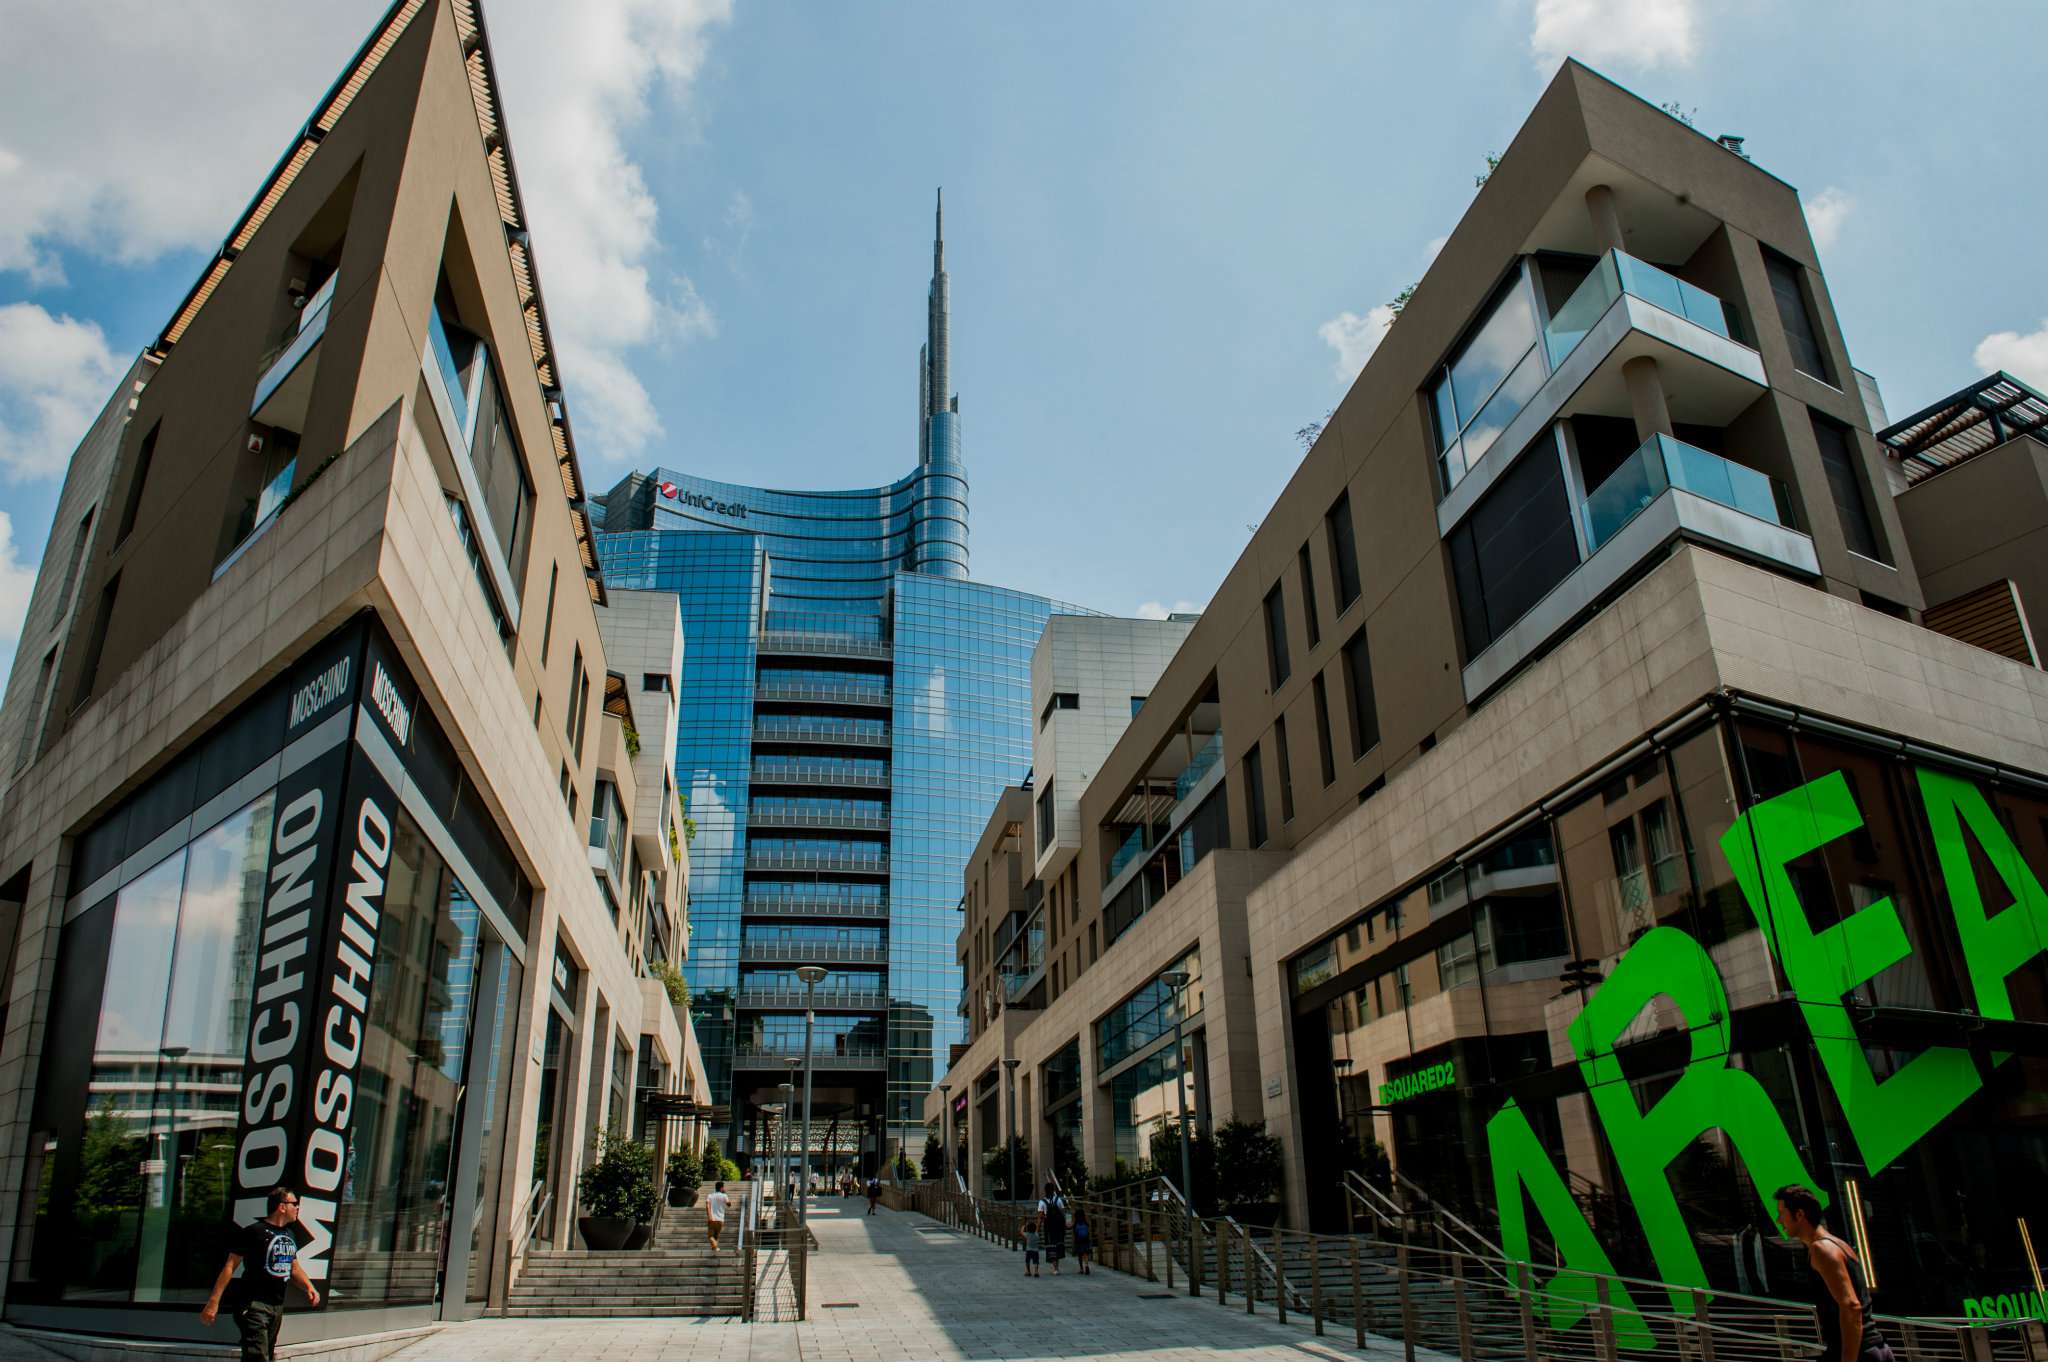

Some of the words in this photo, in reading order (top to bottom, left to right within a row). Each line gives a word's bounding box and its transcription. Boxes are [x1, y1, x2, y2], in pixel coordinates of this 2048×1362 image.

[678, 489, 747, 518] UniCredit
[289, 655, 350, 729] MOSCHINO
[371, 660, 410, 747] MOSCHINO
[296, 797, 391, 1280] MOSCHINO
